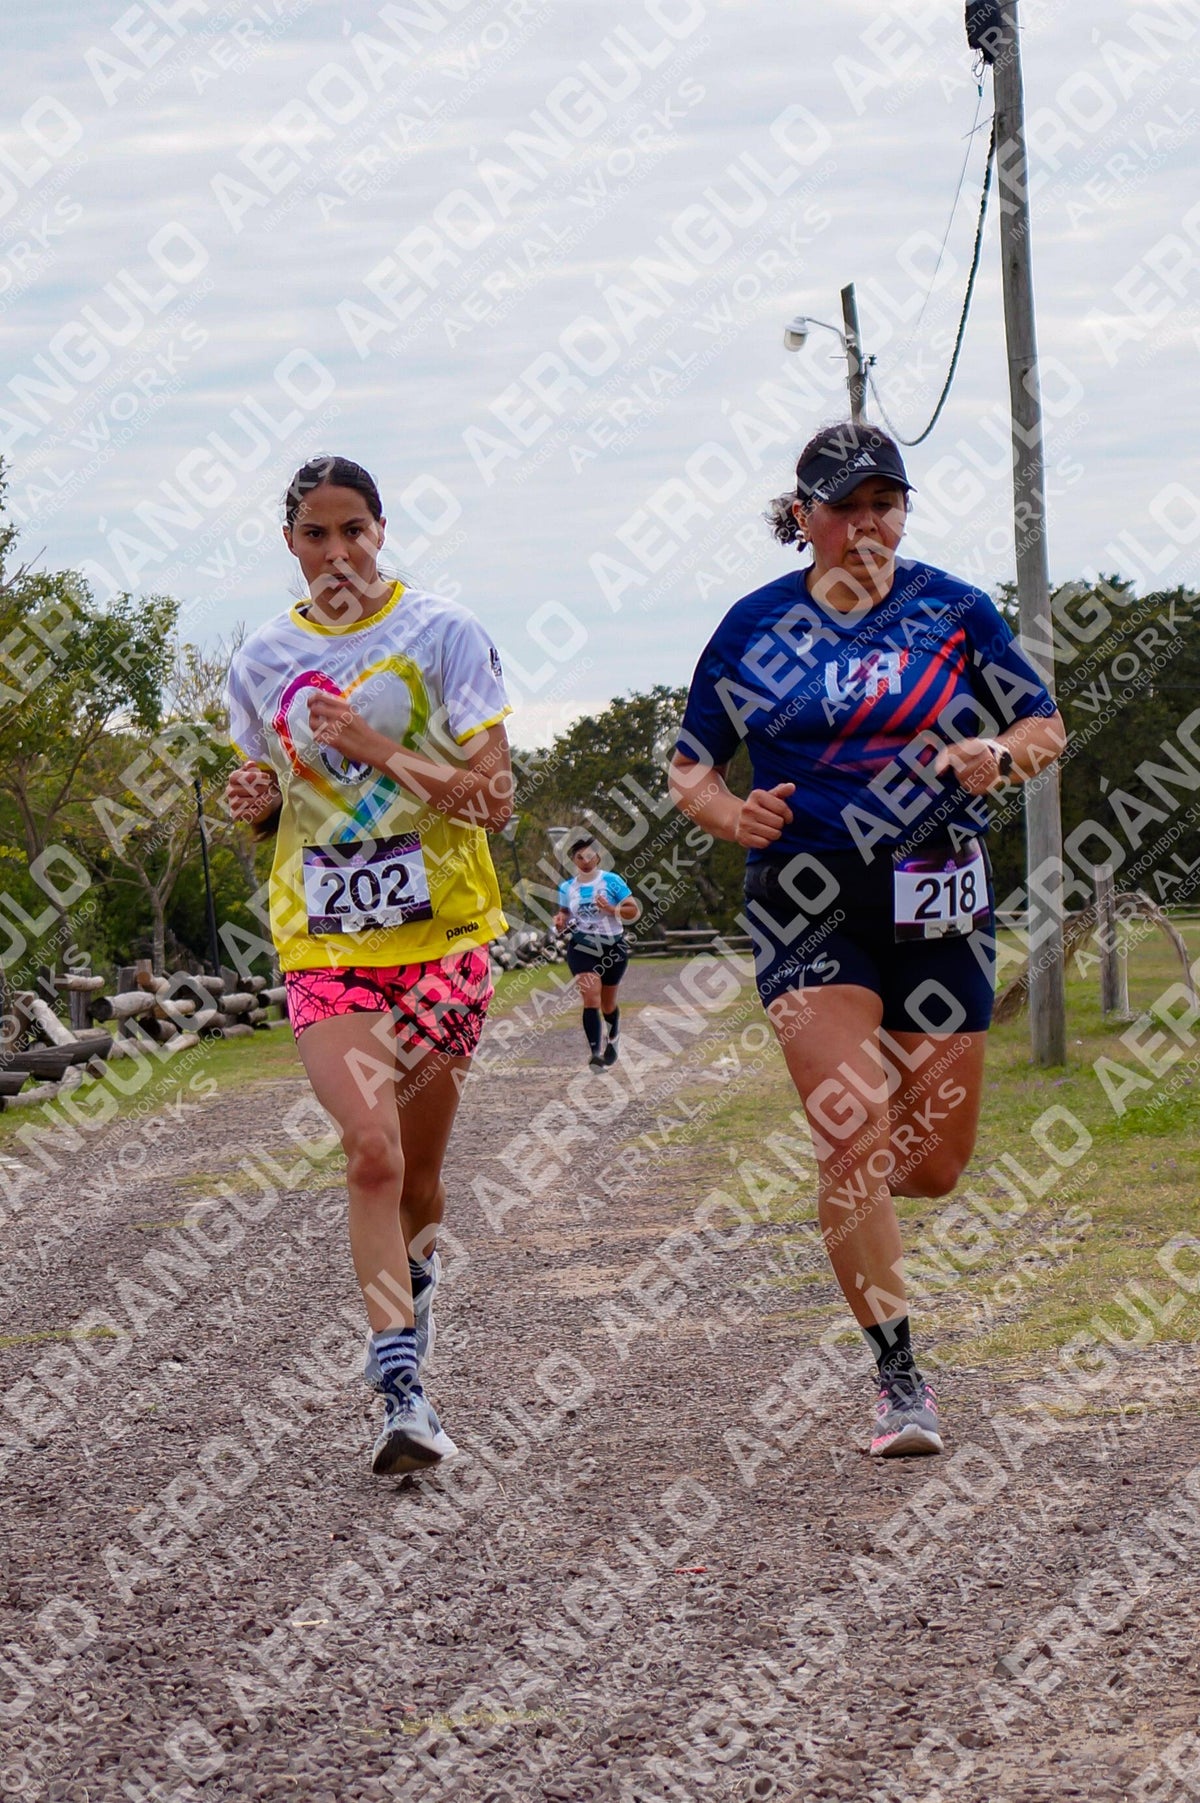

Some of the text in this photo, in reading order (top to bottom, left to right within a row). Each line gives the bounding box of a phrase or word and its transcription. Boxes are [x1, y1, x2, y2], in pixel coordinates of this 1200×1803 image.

[320, 863, 415, 915] 202
[914, 870, 976, 921] 218
[446, 921, 480, 942] panda
